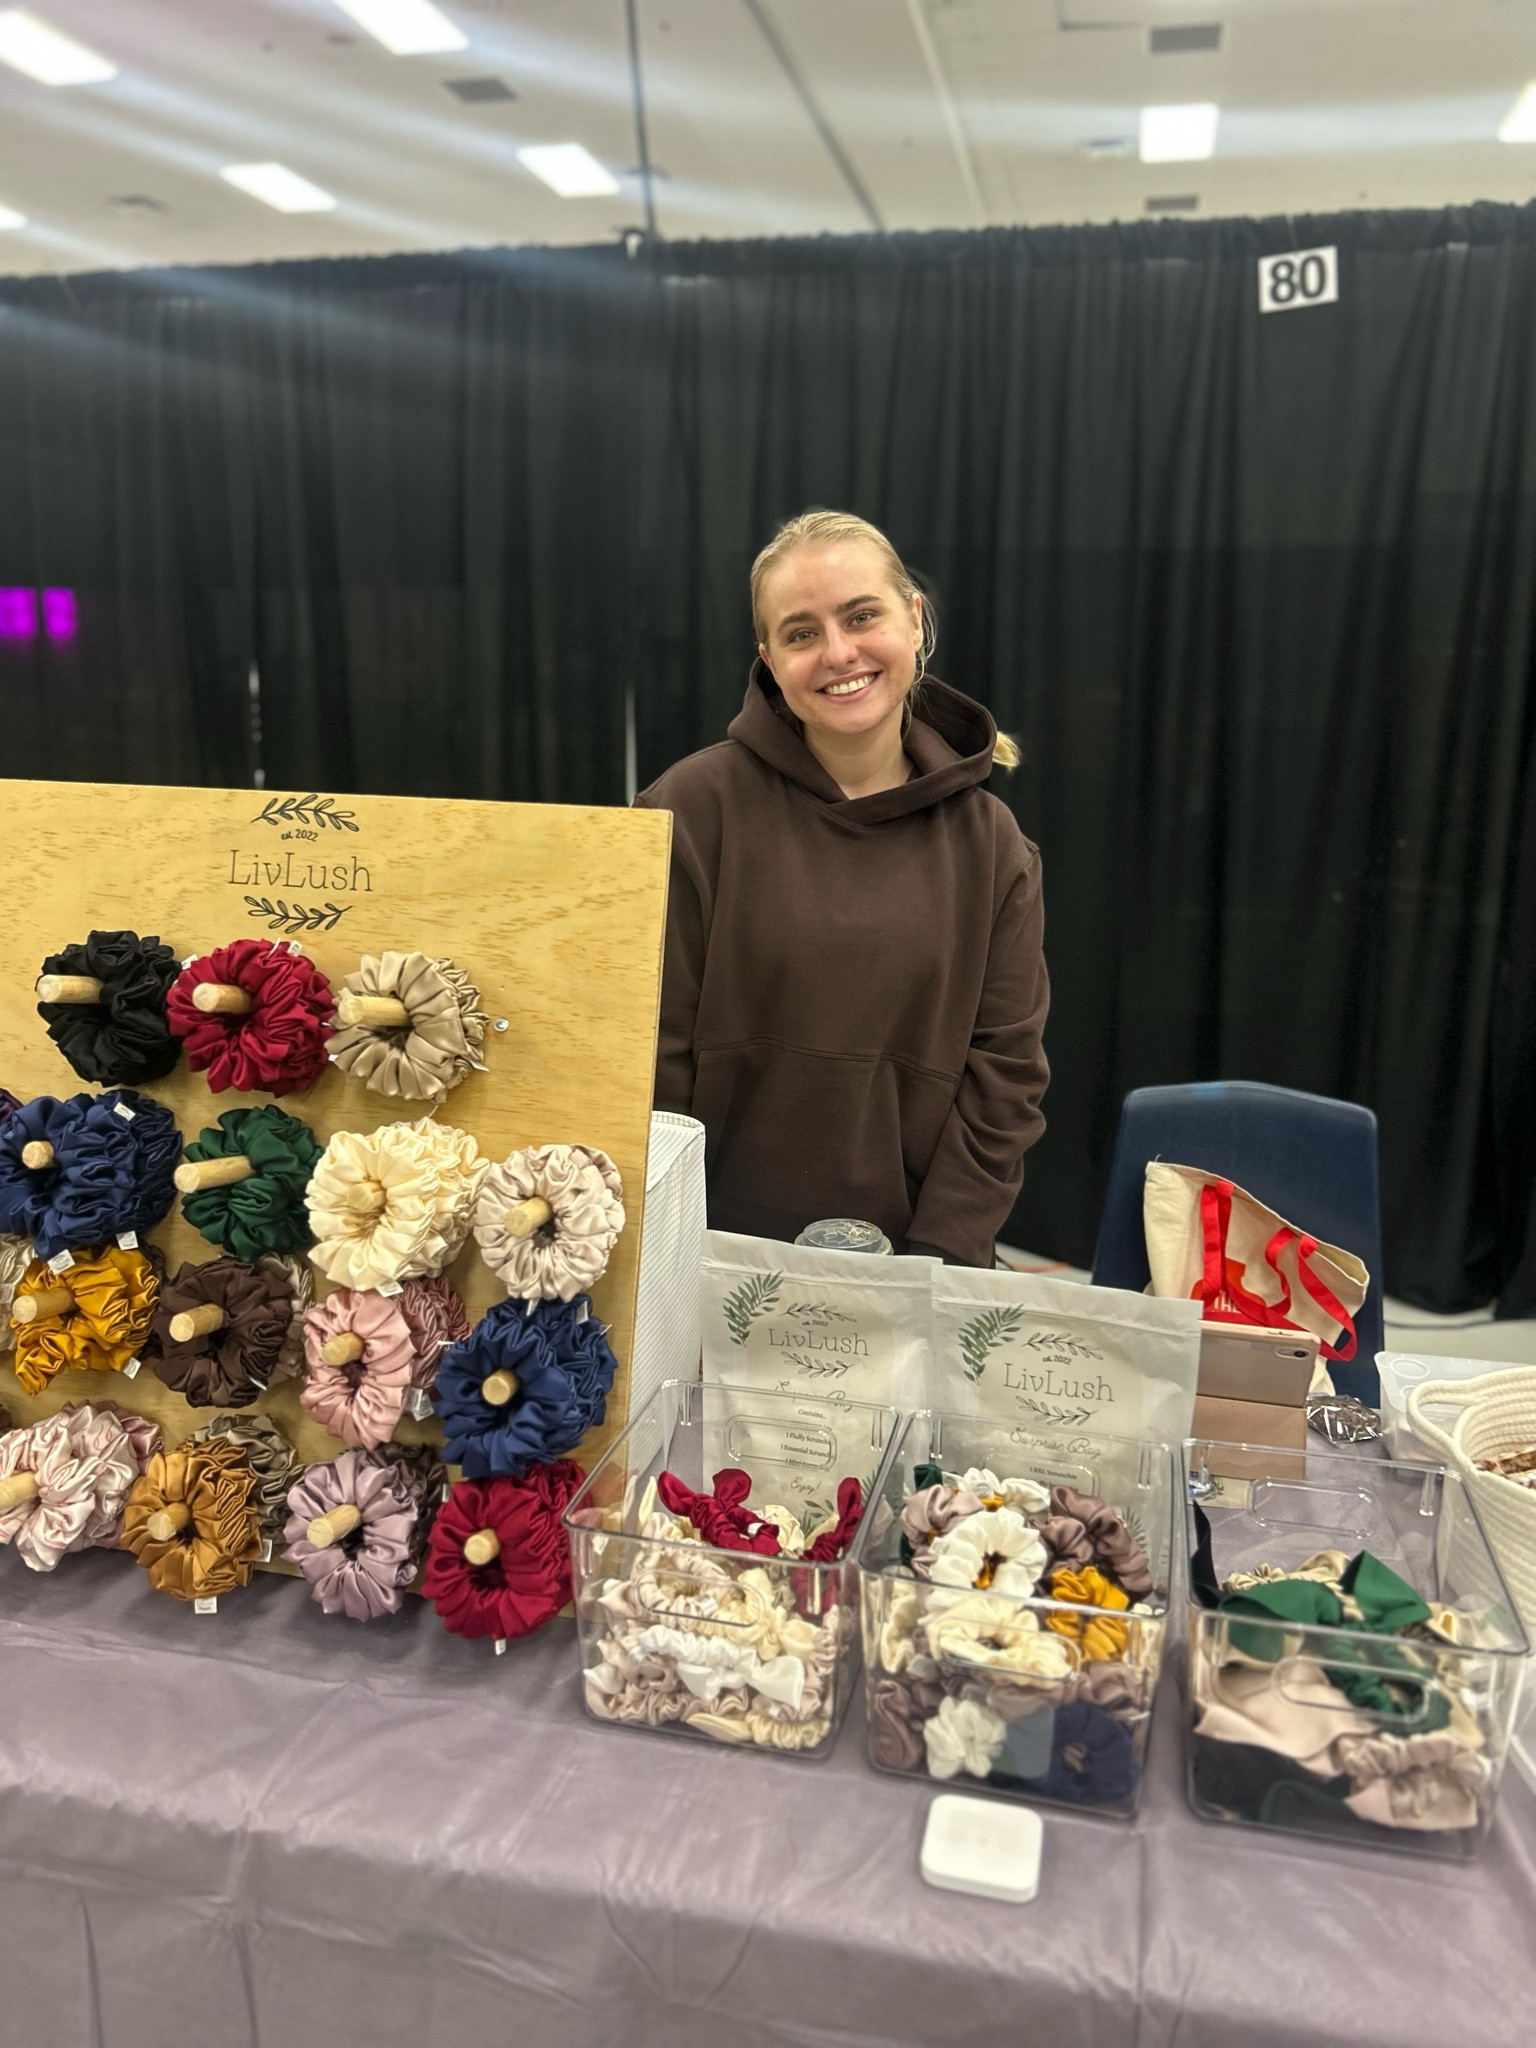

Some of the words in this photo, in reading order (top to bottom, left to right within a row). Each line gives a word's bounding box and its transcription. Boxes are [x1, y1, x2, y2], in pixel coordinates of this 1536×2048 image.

[1269, 254, 1327, 304] 80
[295, 828, 319, 843] 2022
[228, 849, 374, 892] LivLush
[767, 1328, 870, 1357] LivLush
[1003, 1362, 1115, 1402] LivLush
